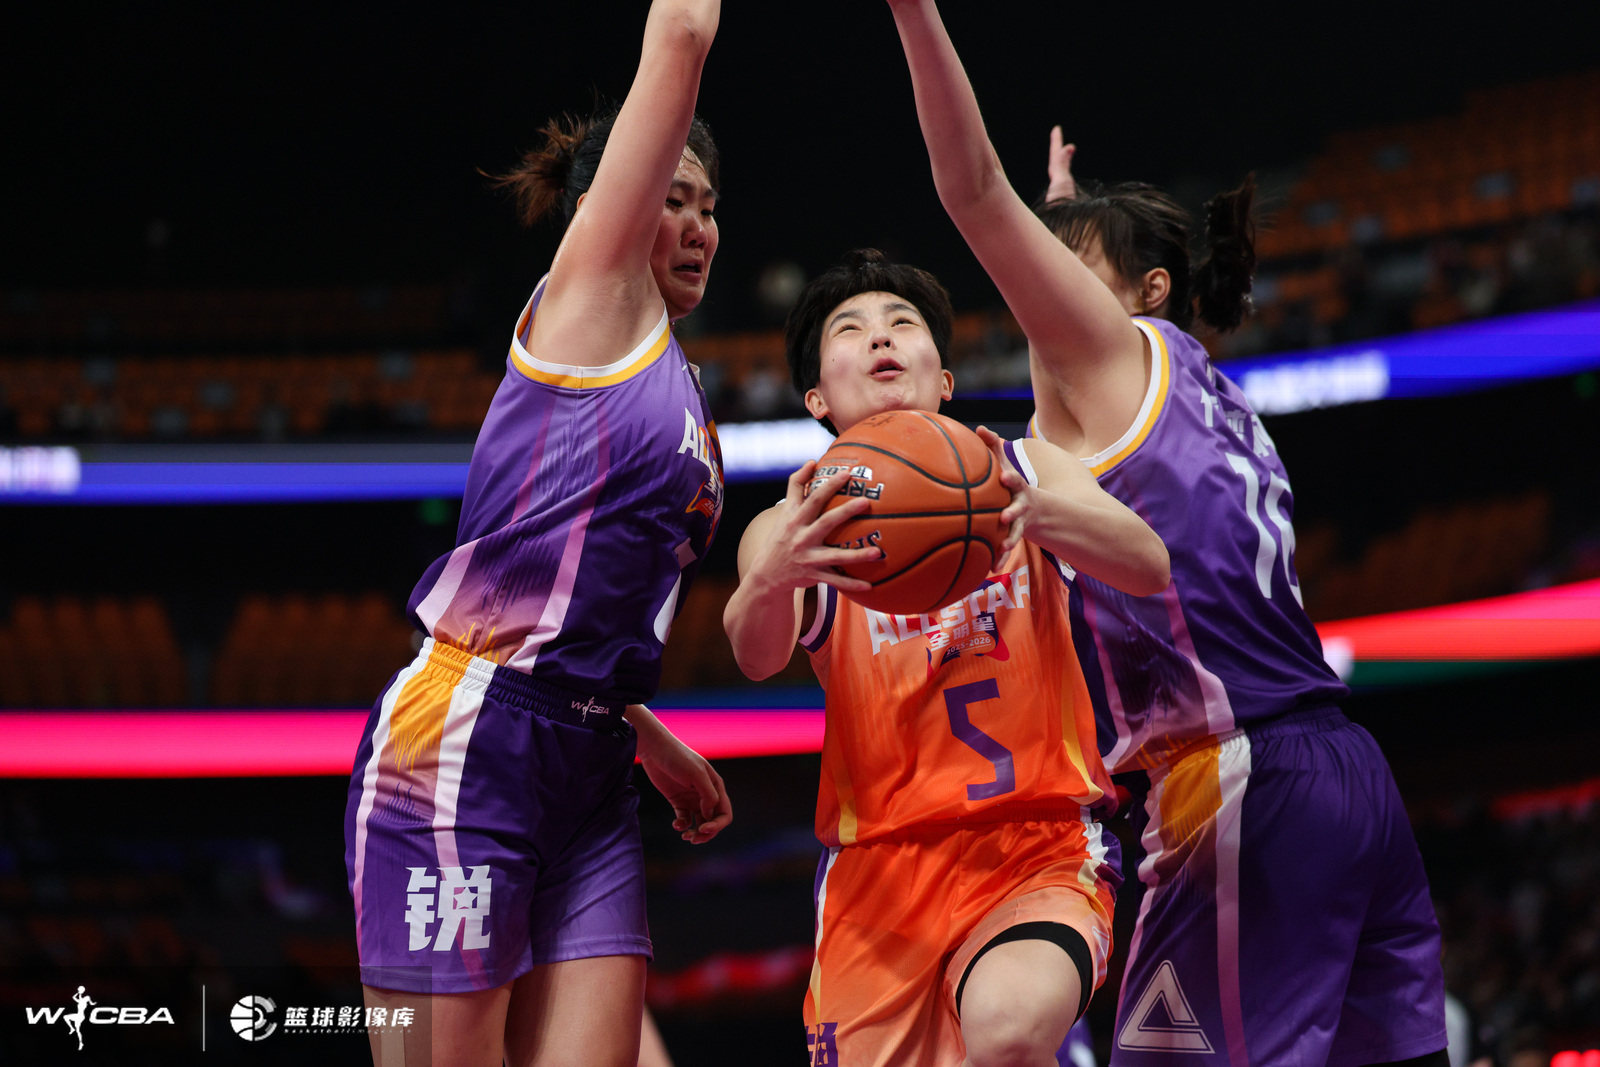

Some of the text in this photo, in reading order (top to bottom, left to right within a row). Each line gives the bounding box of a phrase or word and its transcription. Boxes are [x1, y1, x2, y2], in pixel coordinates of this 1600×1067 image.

[946, 636, 992, 656] 2025-2026
[943, 677, 1016, 801] 5
[404, 865, 492, 952] 锐
